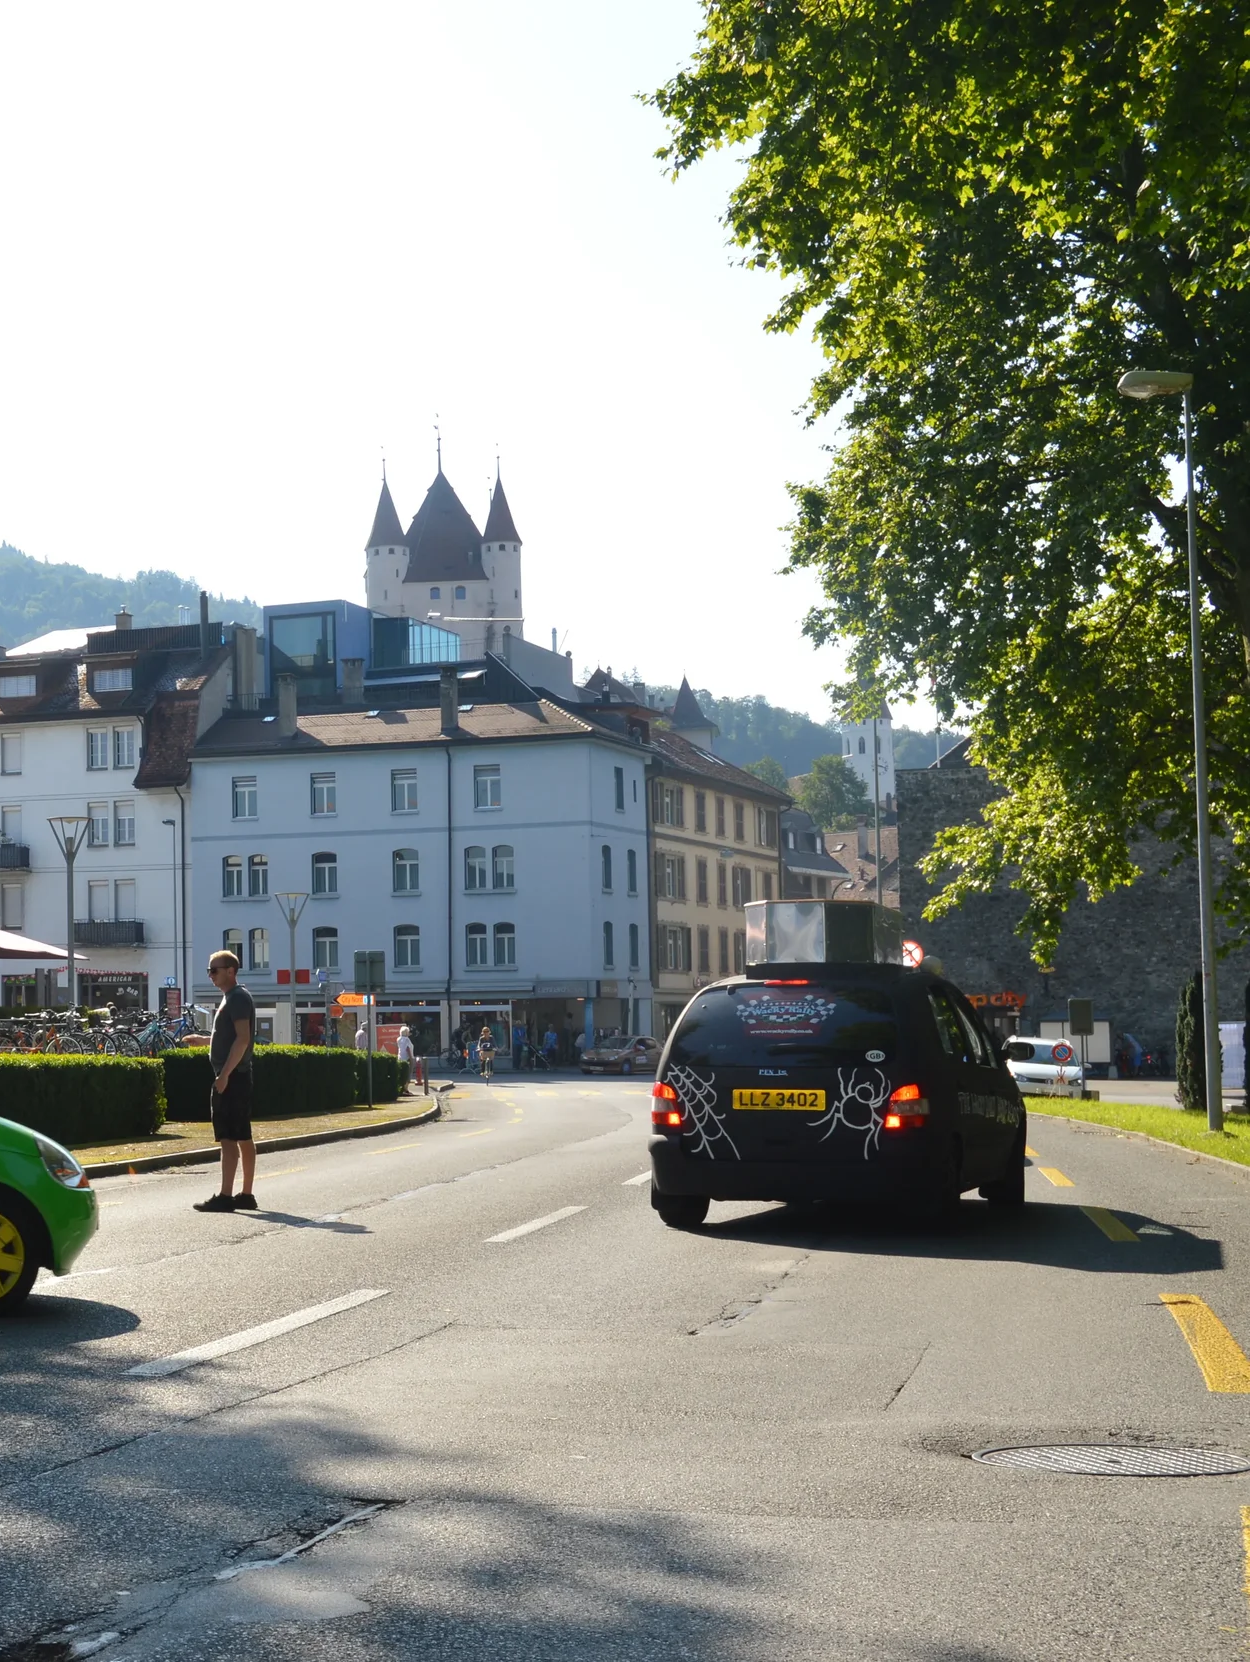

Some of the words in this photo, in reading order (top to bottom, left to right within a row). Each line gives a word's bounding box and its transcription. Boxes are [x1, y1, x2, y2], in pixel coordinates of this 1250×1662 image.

[126, 986, 139, 997] BAR
[990, 991, 1027, 1009] city
[788, 1006, 816, 1016] Rally
[869, 1052, 881, 1060] GB
[739, 1092, 770, 1107] LLZ
[776, 1092, 818, 1107] 3402
